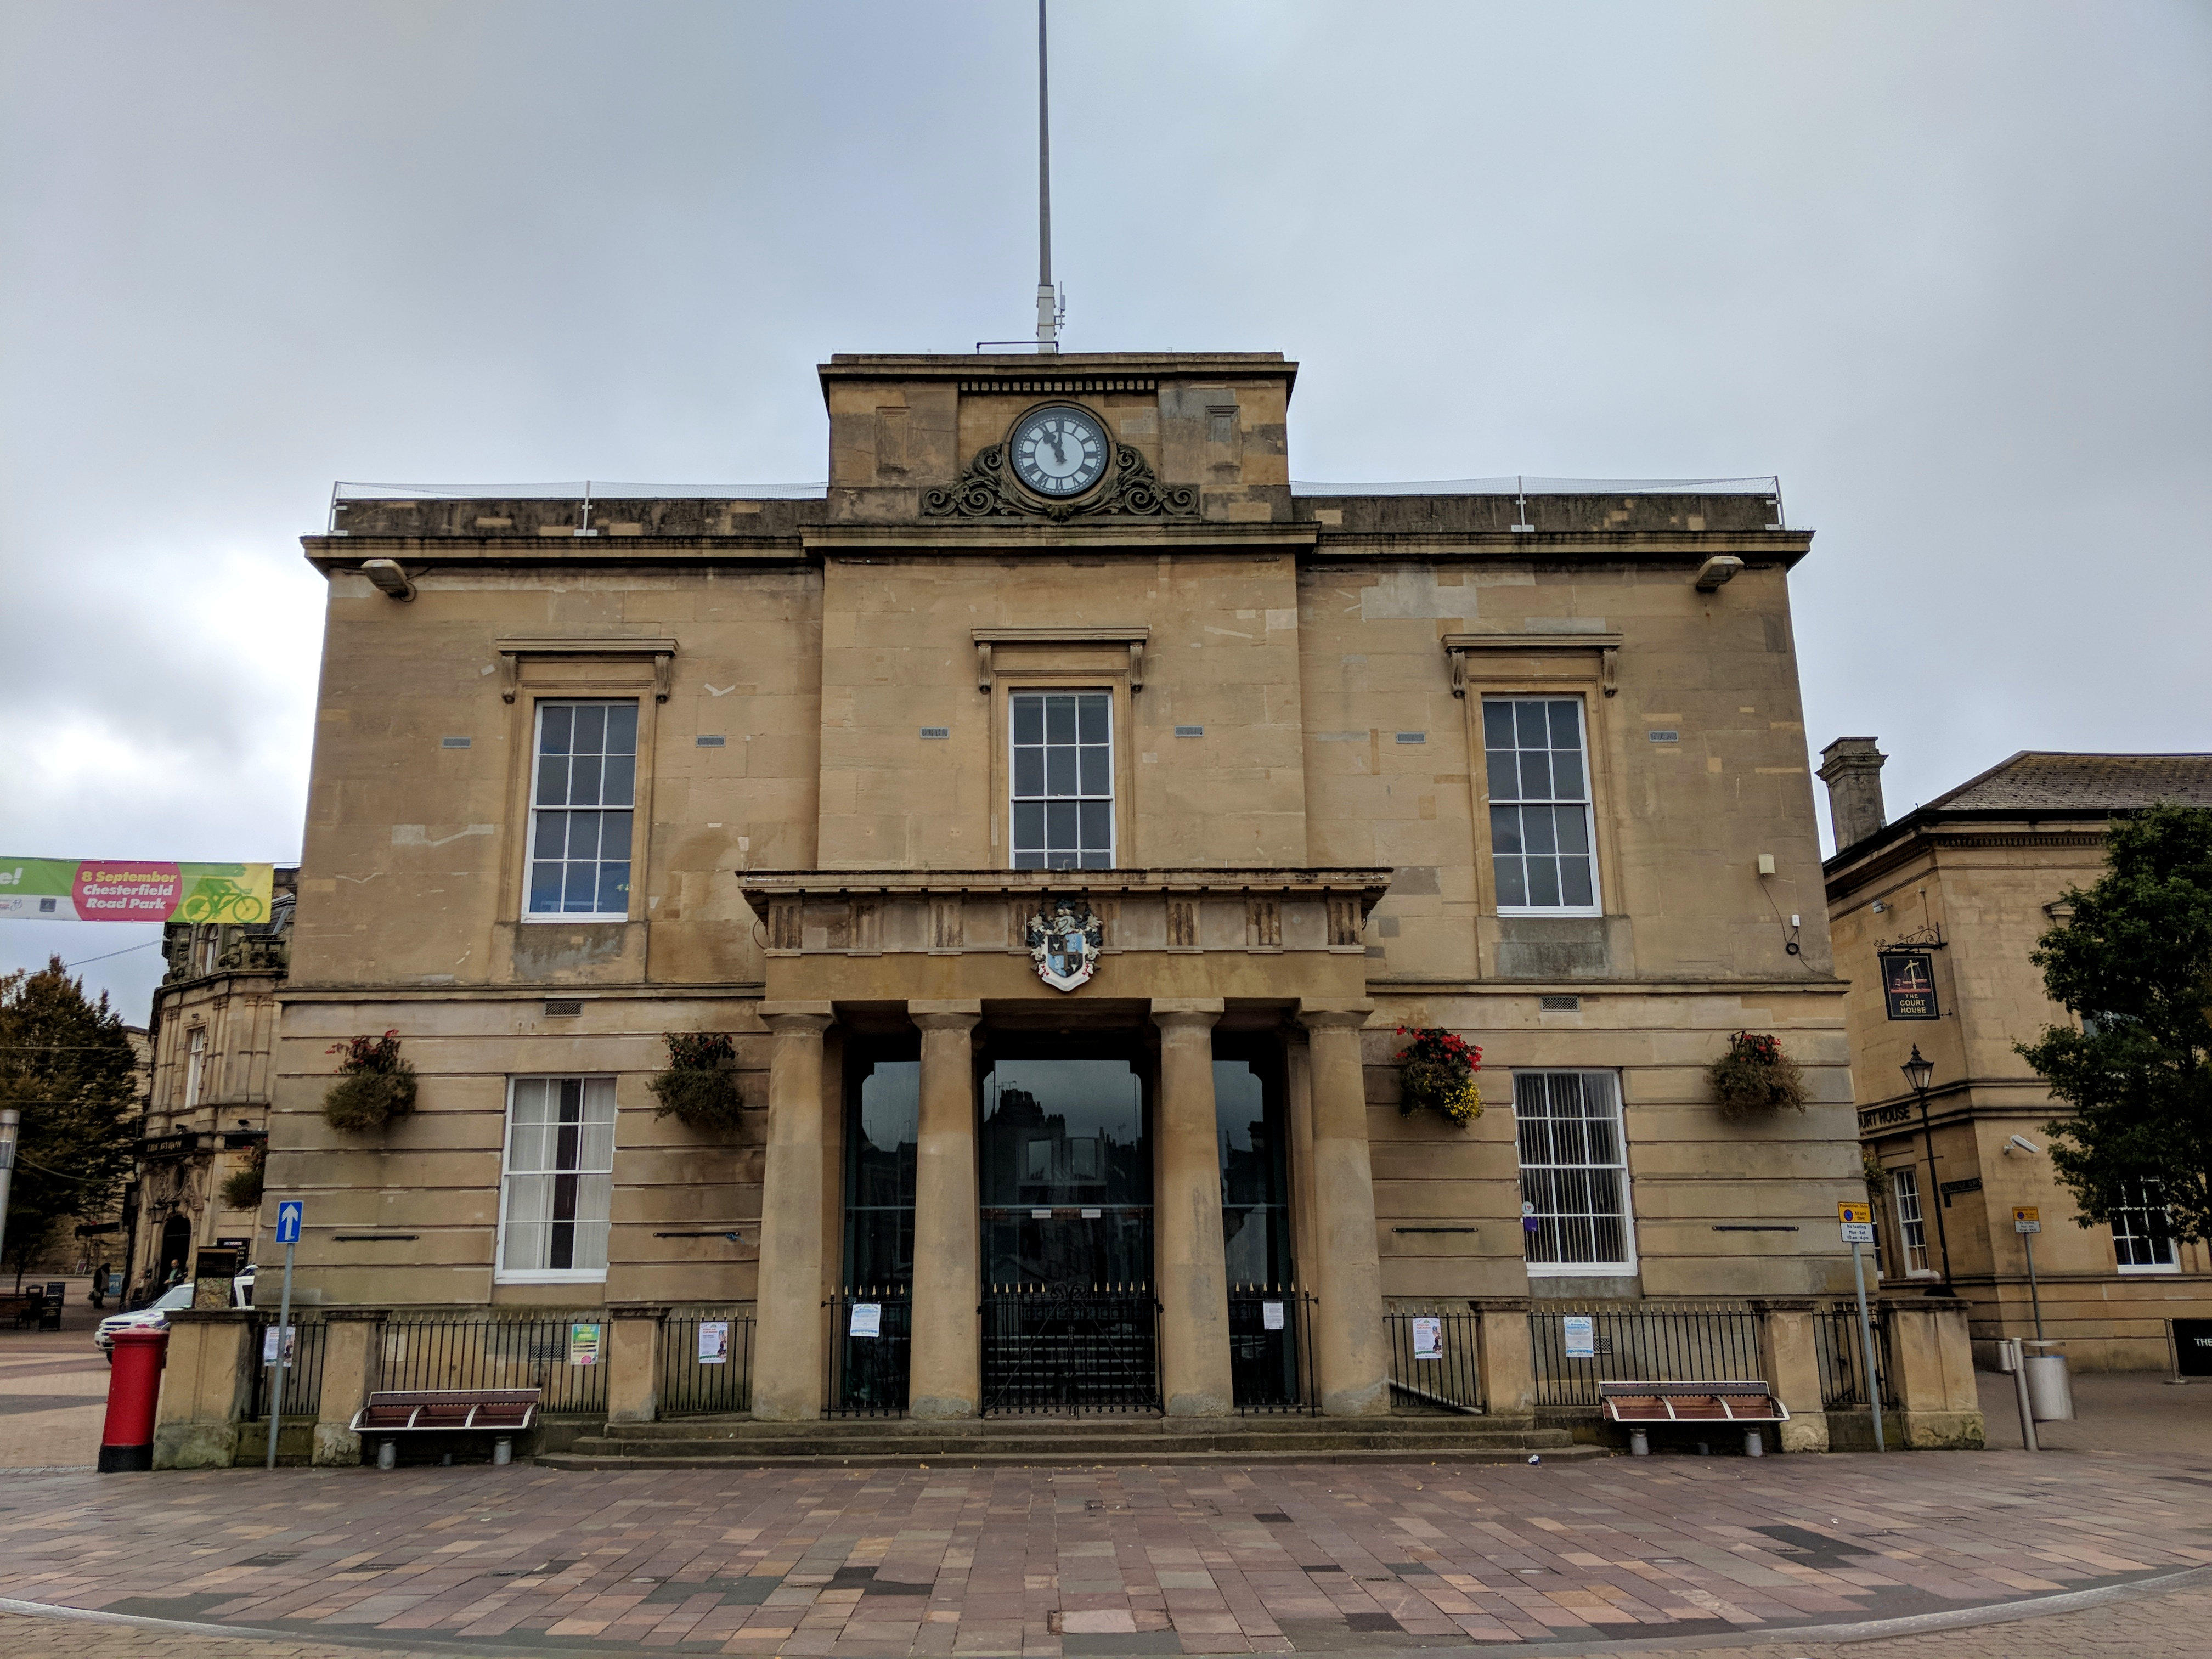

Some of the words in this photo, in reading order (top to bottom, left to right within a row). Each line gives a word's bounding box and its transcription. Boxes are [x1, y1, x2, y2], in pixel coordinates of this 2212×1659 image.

[82, 871, 92, 882] 8
[95, 871, 177, 884] September
[83, 884, 174, 896] Chesterfield
[86, 898, 127, 909] Road
[129, 899, 167, 909] Park
[1879, 1104, 1910, 1124] HOUSE
[2194, 1338, 2212, 1346] THE
